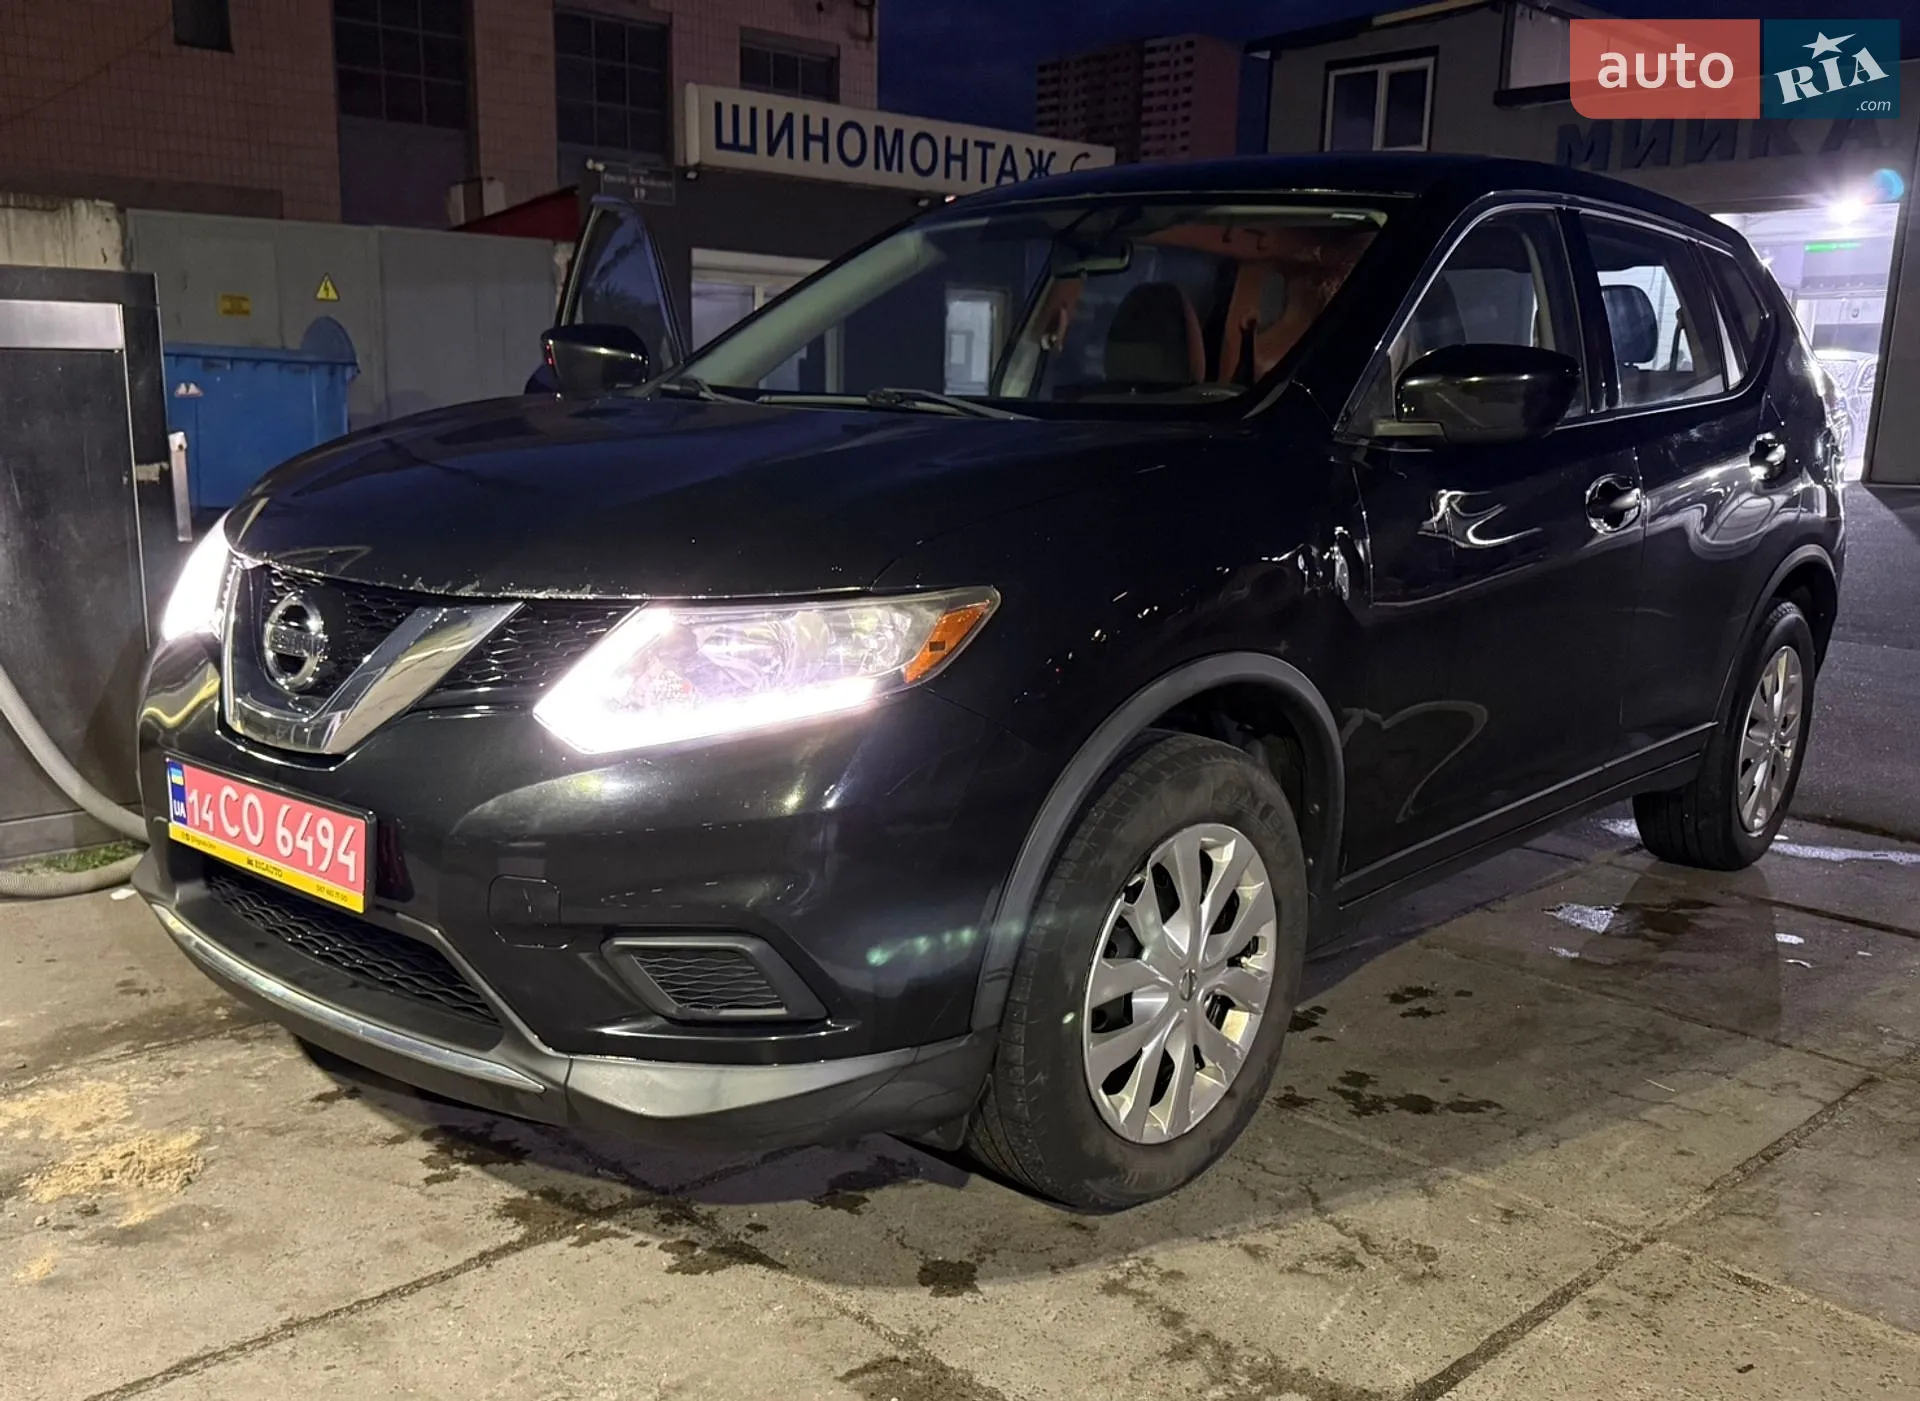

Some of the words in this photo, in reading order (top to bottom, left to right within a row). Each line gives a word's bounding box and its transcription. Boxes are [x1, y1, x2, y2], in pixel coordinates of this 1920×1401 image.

[714, 101, 1056, 184] ШИНОМОНТАЖ
[173, 801, 186, 819] UA
[276, 804, 357, 882] 6494
